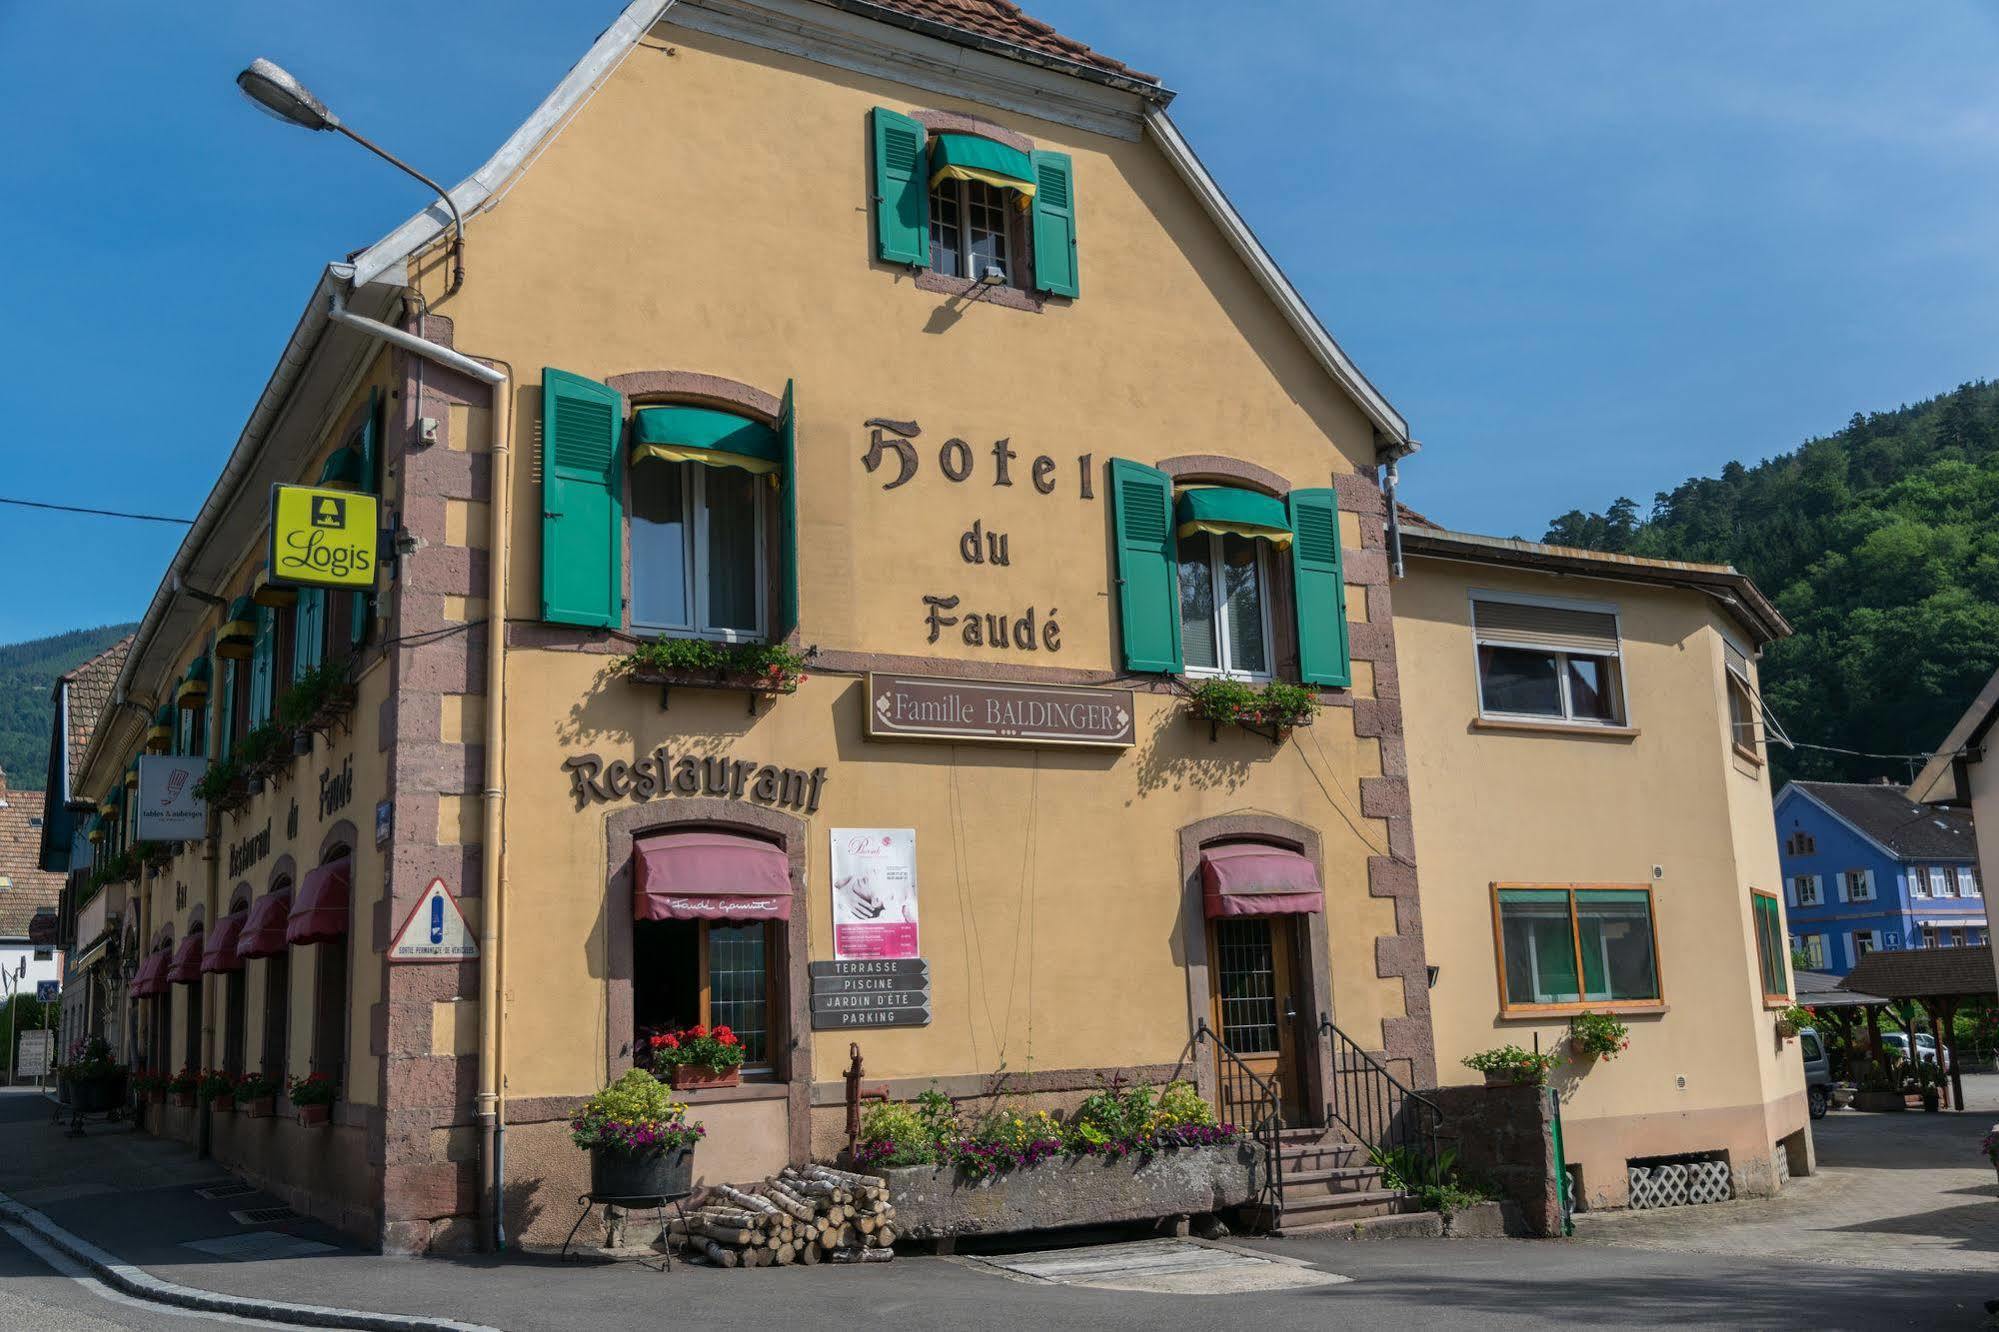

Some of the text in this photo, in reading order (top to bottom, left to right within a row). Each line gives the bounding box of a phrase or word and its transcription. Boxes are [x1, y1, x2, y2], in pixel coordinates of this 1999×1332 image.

[861, 417, 1094, 500] Hotel
[282, 529, 370, 577] Logis
[959, 518, 1010, 567] du
[922, 594, 1062, 652] Faudé
[895, 693, 1114, 730] Famille BALDINGER
[562, 747, 828, 812] Restaurant
[229, 816, 271, 880] Restaurant
[287, 797, 299, 840] du
[835, 961, 898, 973] TERRASSE
[844, 978, 893, 989] PISCINE
[826, 996, 870, 1007] JARDIN
[842, 1011, 895, 1023] PARKING
